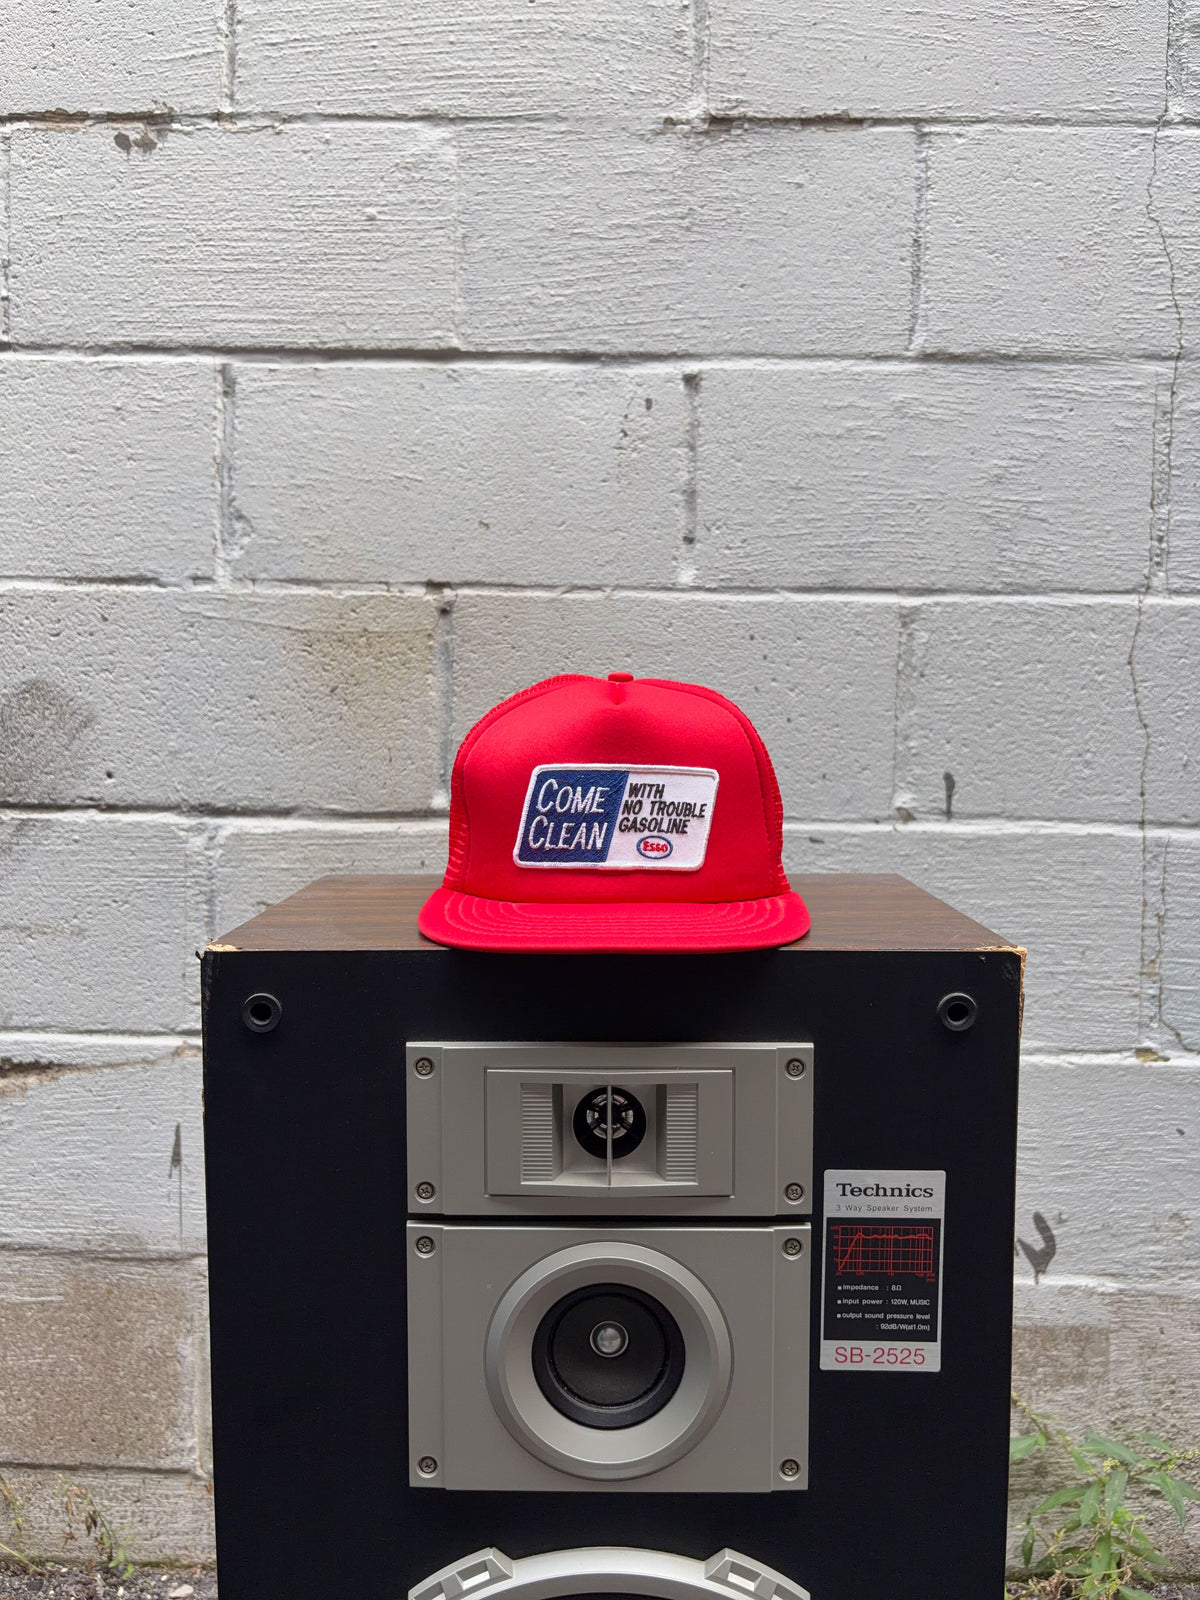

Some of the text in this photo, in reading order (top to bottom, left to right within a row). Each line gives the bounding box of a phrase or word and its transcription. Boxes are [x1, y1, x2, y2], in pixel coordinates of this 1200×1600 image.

[536, 778, 610, 813] COME
[628, 783, 665, 799] WITH
[622, 799, 707, 818] NO TROUBLE
[529, 815, 608, 850] CLEAN
[619, 817, 690, 834] GASOLINE
[836, 1183, 933, 1198] Technics
[835, 1347, 925, 1365] SB-2525
